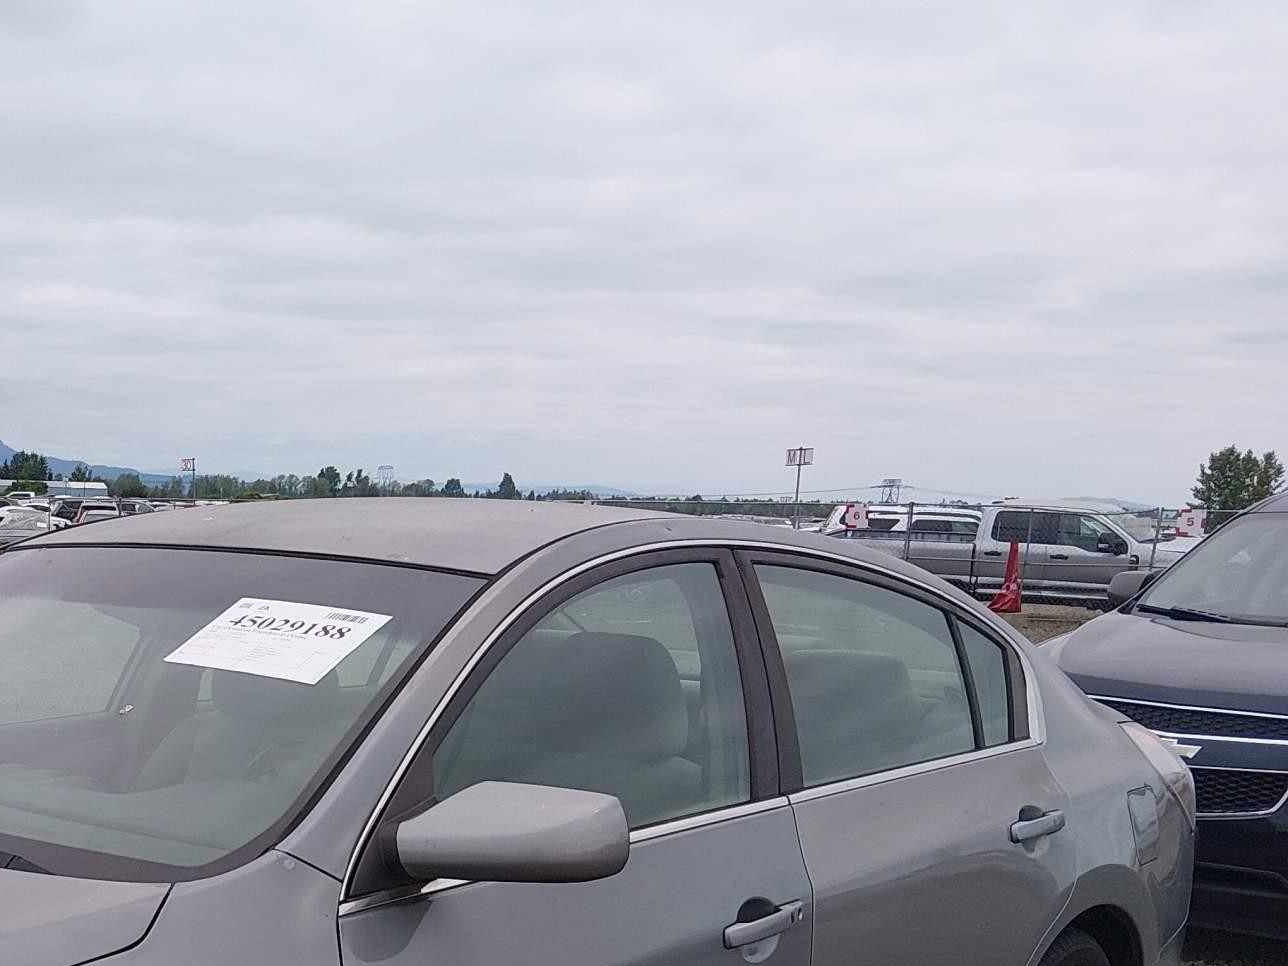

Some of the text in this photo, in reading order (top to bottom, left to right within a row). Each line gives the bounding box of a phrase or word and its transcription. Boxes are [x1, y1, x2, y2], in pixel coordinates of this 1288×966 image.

[853, 511, 860, 520] 6
[1186, 517, 1195, 527] 5
[229, 614, 353, 640] 45029188
